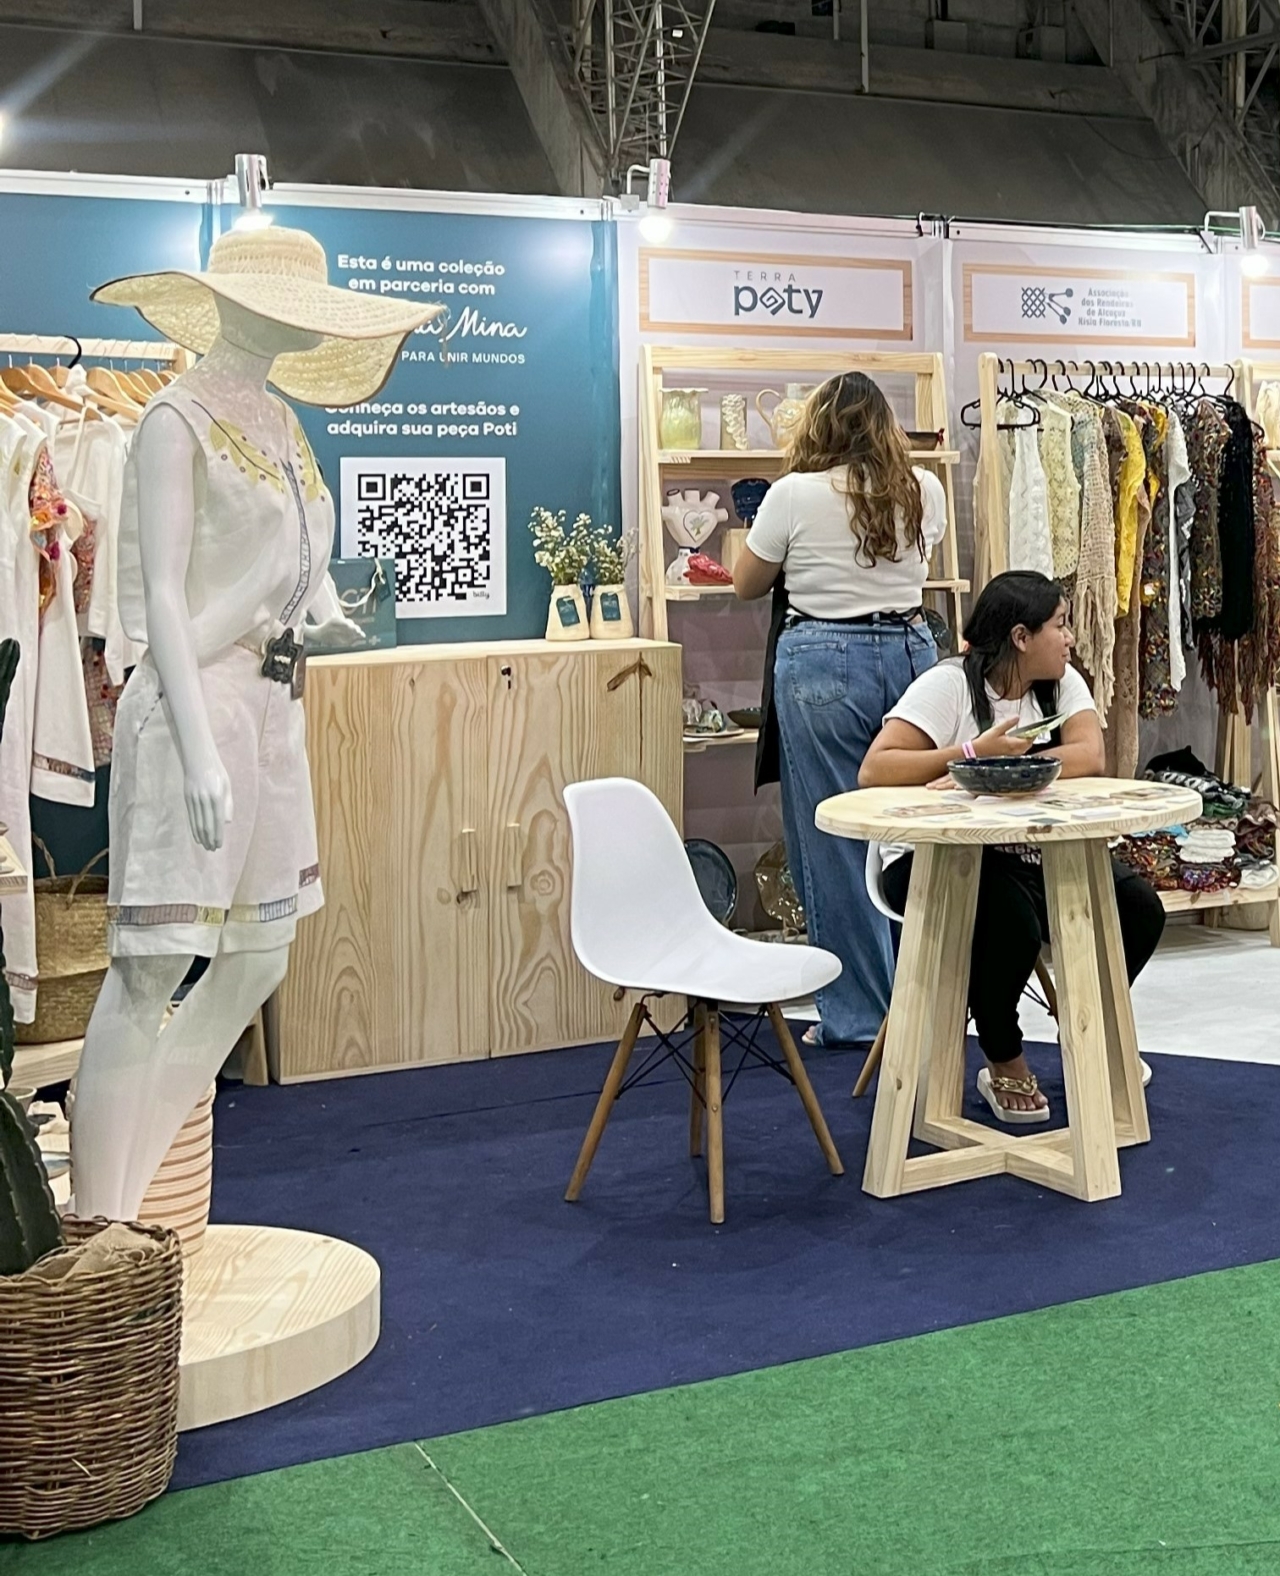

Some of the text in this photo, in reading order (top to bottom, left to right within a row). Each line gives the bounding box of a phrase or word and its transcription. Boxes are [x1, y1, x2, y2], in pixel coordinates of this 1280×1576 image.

[338, 254, 506, 277] Esta é uma coleção
[733, 270, 797, 283] TERRA
[348, 278, 495, 295] em parceria com
[1086, 308, 1096, 317] de
[438, 306, 528, 343] Mina
[402, 351, 525, 364] PARA UNIR MUNDOS
[407, 404, 427, 415] os
[431, 401, 506, 416] artesãos
[510, 405, 520, 416] e
[327, 420, 517, 438] adquira sua peça Poti
